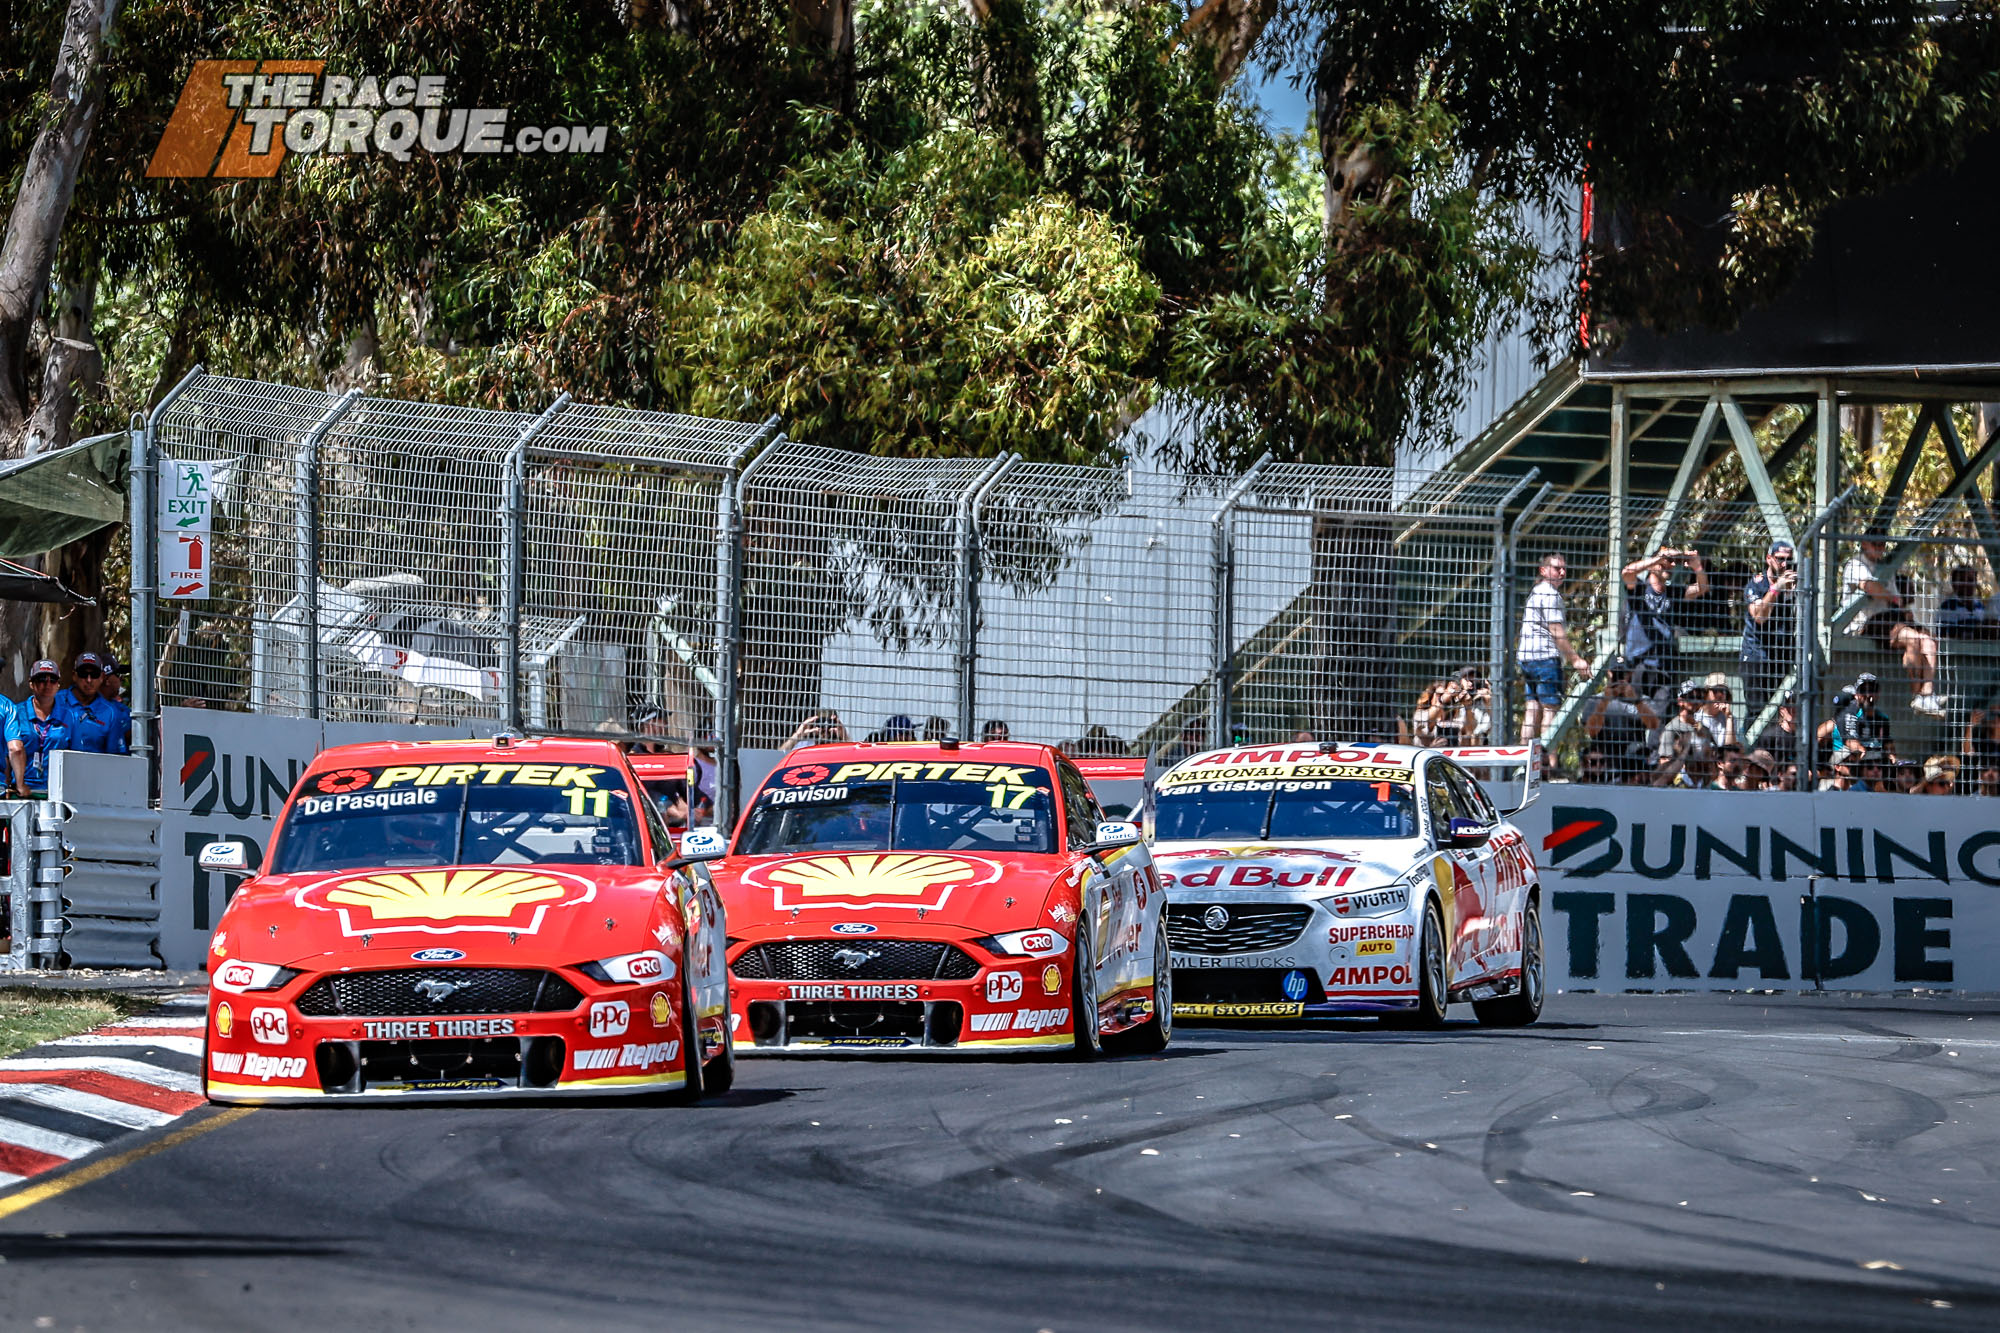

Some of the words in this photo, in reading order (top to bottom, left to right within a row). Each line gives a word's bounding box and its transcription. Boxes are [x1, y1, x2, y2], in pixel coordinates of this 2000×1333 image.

[168, 500, 207, 514] EXIT
[1190, 750, 1402, 766] AMPOL
[180, 734, 308, 821] BUN
[373, 763, 607, 789] PIRTEK
[829, 763, 1036, 785] PIRTEK
[1169, 767, 1284, 783] NATIONAL
[1295, 765, 1411, 781] STORAGE
[771, 786, 849, 805] Davison
[1213, 780, 1332, 793] Gisbergen
[1369, 781, 1392, 801] 1
[561, 787, 609, 818] 11
[985, 785, 1038, 810] 17
[1230, 866, 1357, 887] Bull
[1023, 935, 1052, 950] CRC
[1329, 924, 1414, 945] SUPERCHEAP
[1552, 891, 1953, 982] TRADE
[1359, 942, 1393, 954] AUTO
[225, 967, 253, 984] CRC
[629, 958, 660, 976] CRC
[1327, 963, 1413, 986] AMPOL
[788, 984, 845, 1000] THREE
[846, 984, 919, 999] THREES
[1287, 970, 1306, 997] hp
[1216, 1003, 1297, 1015] STORAGE
[364, 1021, 432, 1039] THREE
[434, 1019, 515, 1037] THREES
